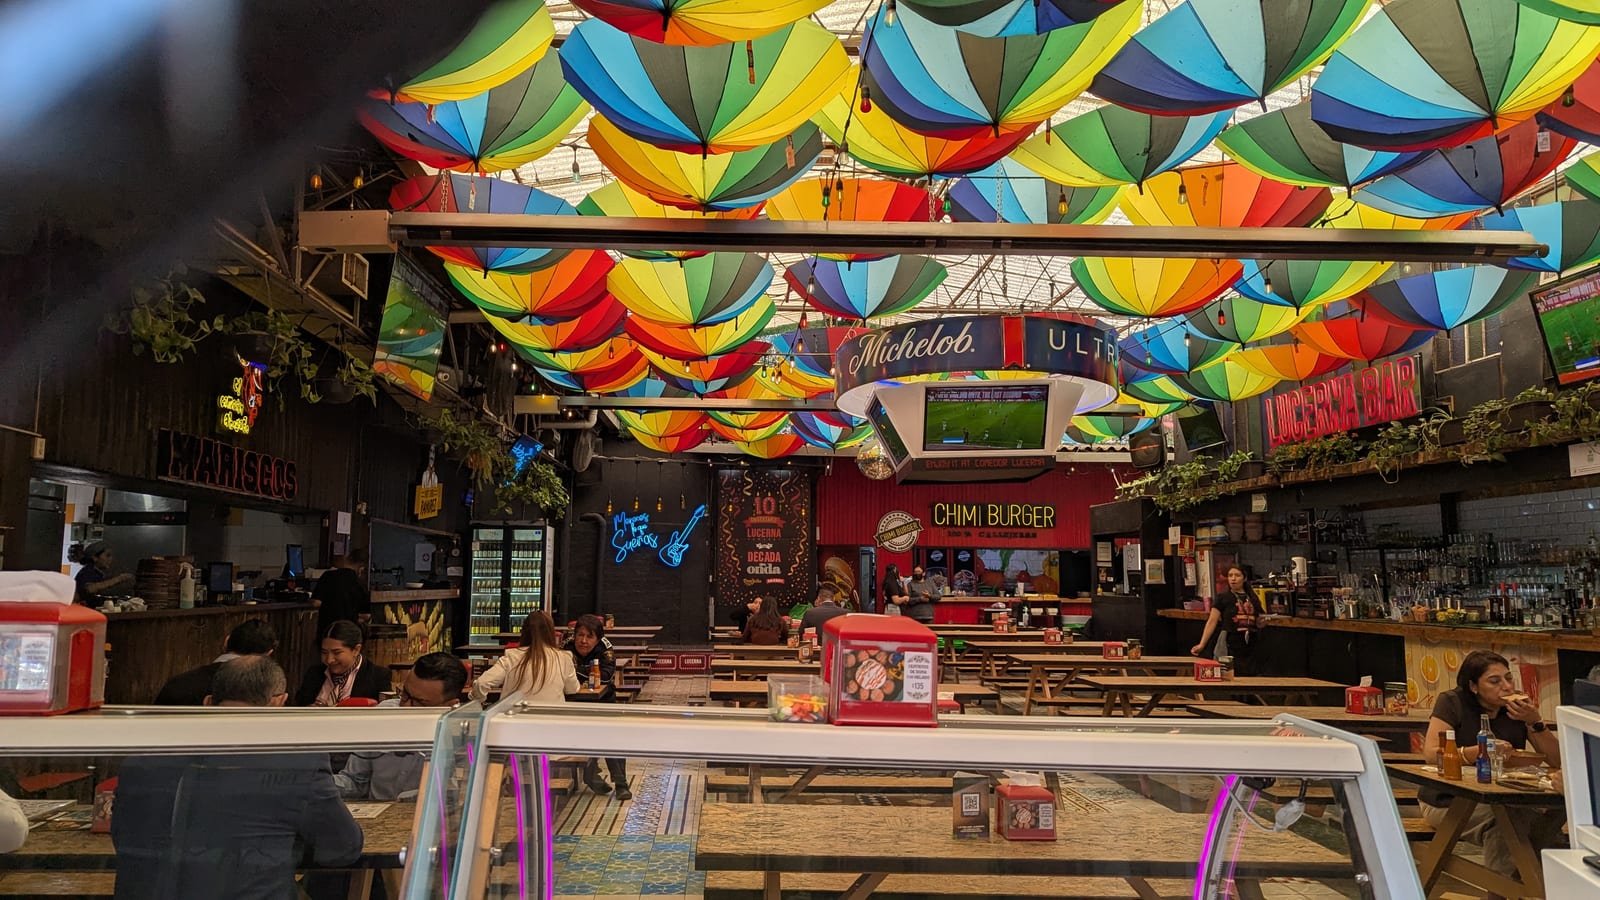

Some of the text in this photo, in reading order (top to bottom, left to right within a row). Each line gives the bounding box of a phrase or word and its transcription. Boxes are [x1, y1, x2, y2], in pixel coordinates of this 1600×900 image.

[1049, 328, 1115, 363] ULTR
[1265, 356, 1418, 447] LUCERNA BAR
[168, 430, 298, 500] MARISCOS
[975, 458, 1008, 467] COMEDOR
[1012, 457, 1045, 467] LUCERNA
[754, 496, 776, 515] 10
[934, 503, 1054, 528] CHIMI BURGER
[747, 527, 781, 538] LUCERNA
[747, 551, 781, 563] DECADA
